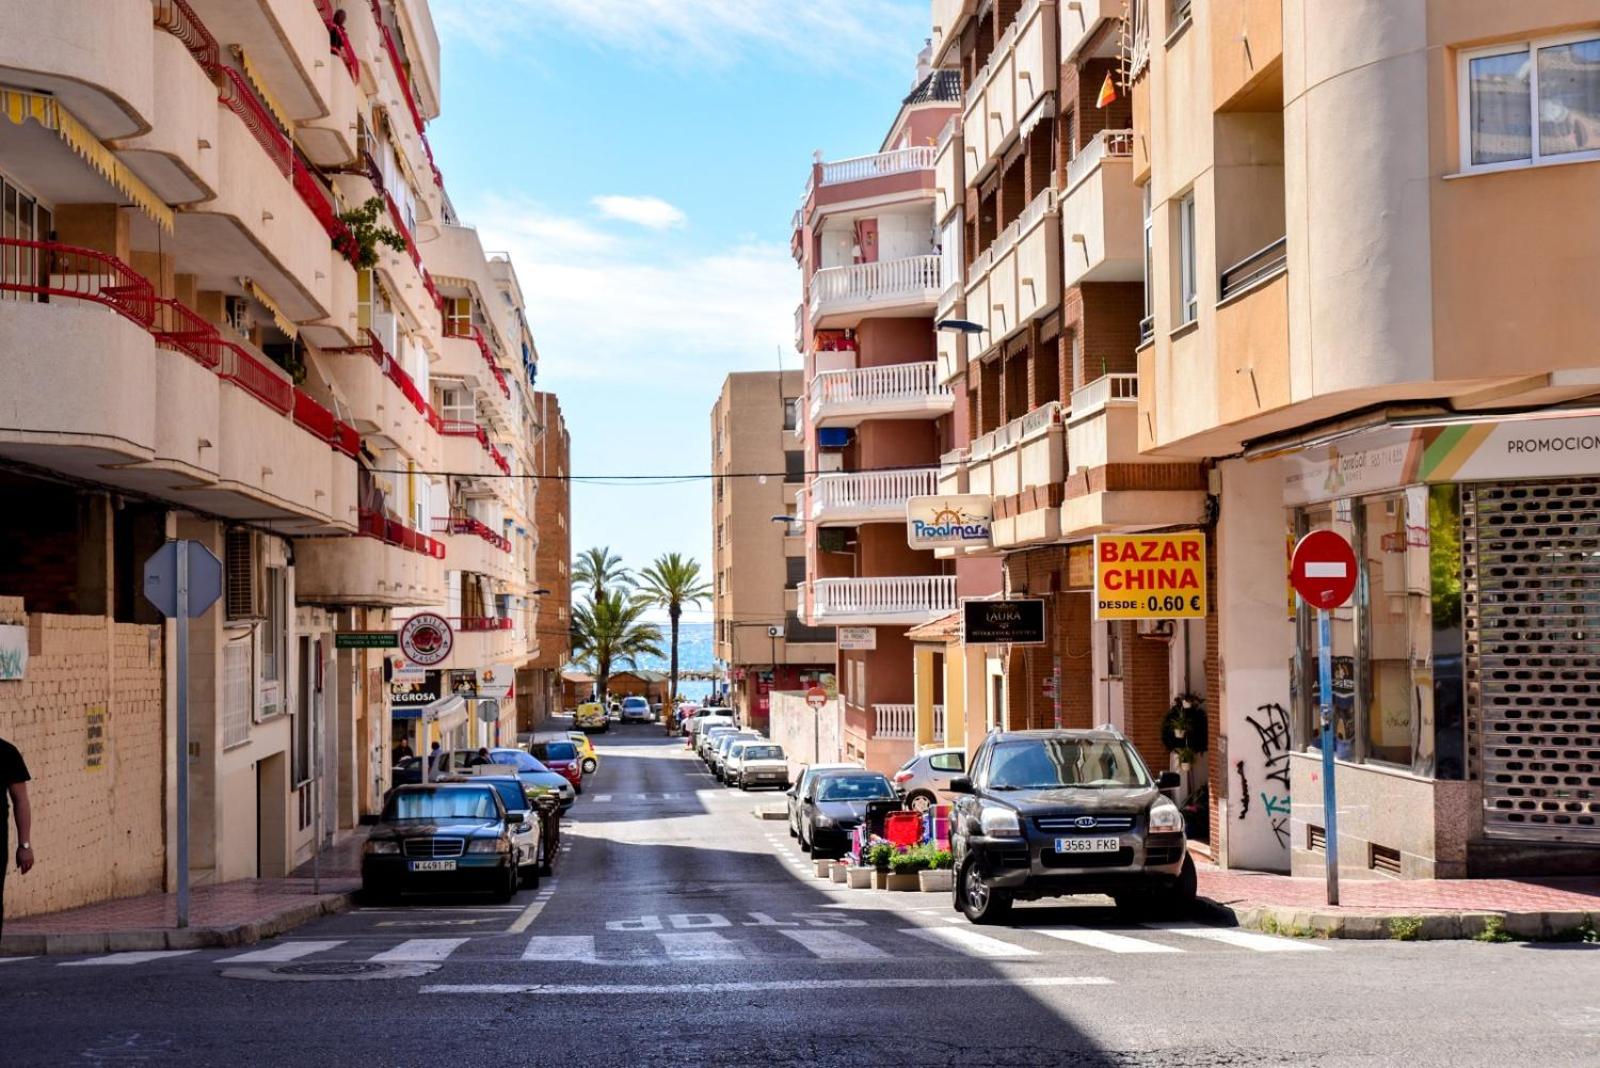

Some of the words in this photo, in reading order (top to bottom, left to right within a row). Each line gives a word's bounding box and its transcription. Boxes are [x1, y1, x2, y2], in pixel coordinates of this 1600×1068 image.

[1100, 541, 1200, 563] BAZAR
[1103, 568, 1200, 591] CHINA
[1099, 600, 1138, 609] DESDE
[1147, 596, 1184, 612] 0.60
[986, 610, 1022, 622] LAURA
[412, 653, 440, 662] VASCA
[1064, 840, 1092, 851] 3563
[1096, 839, 1117, 850] FKB
[606, 912, 869, 931] STOP
